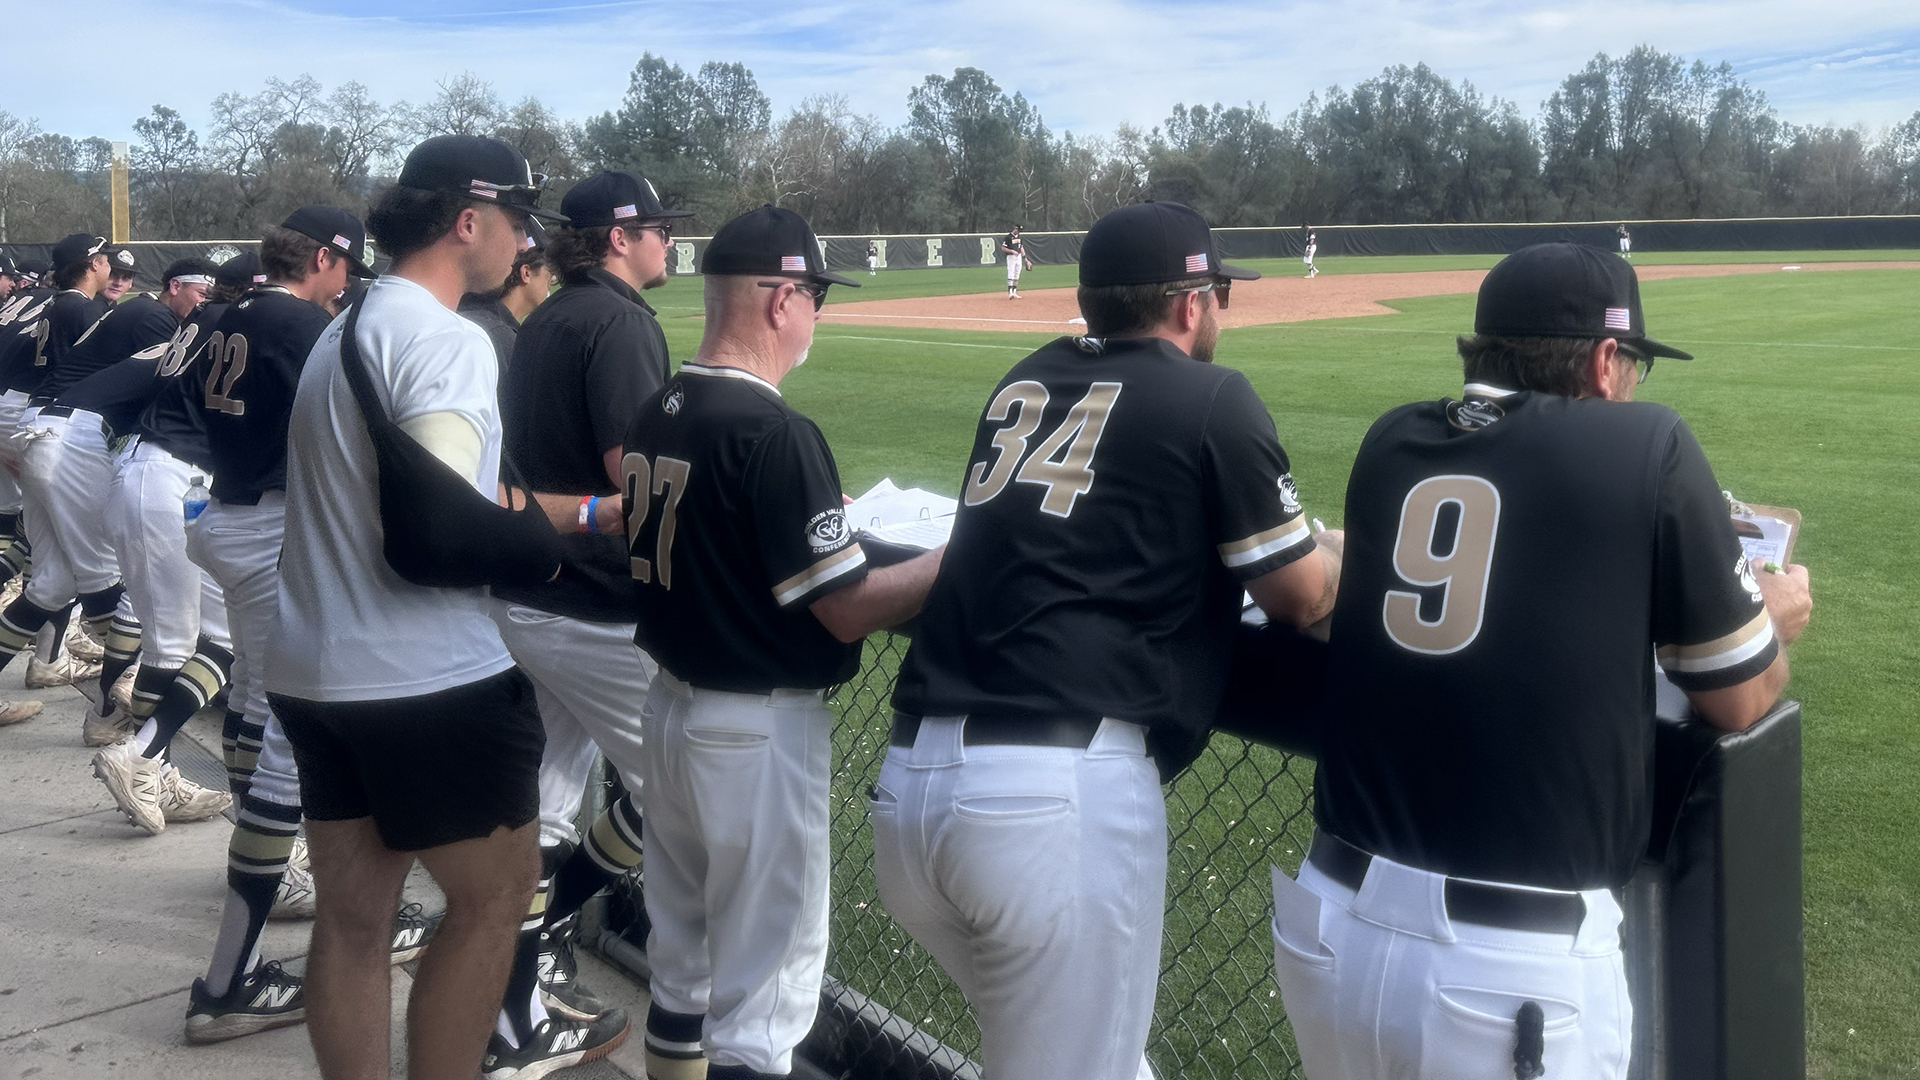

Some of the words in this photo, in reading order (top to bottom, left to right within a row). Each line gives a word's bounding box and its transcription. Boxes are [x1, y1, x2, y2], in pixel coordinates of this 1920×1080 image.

[205, 331, 248, 415] 22
[964, 380, 1124, 519] 34
[621, 452, 691, 591] 27
[1383, 474, 1501, 656] 9
